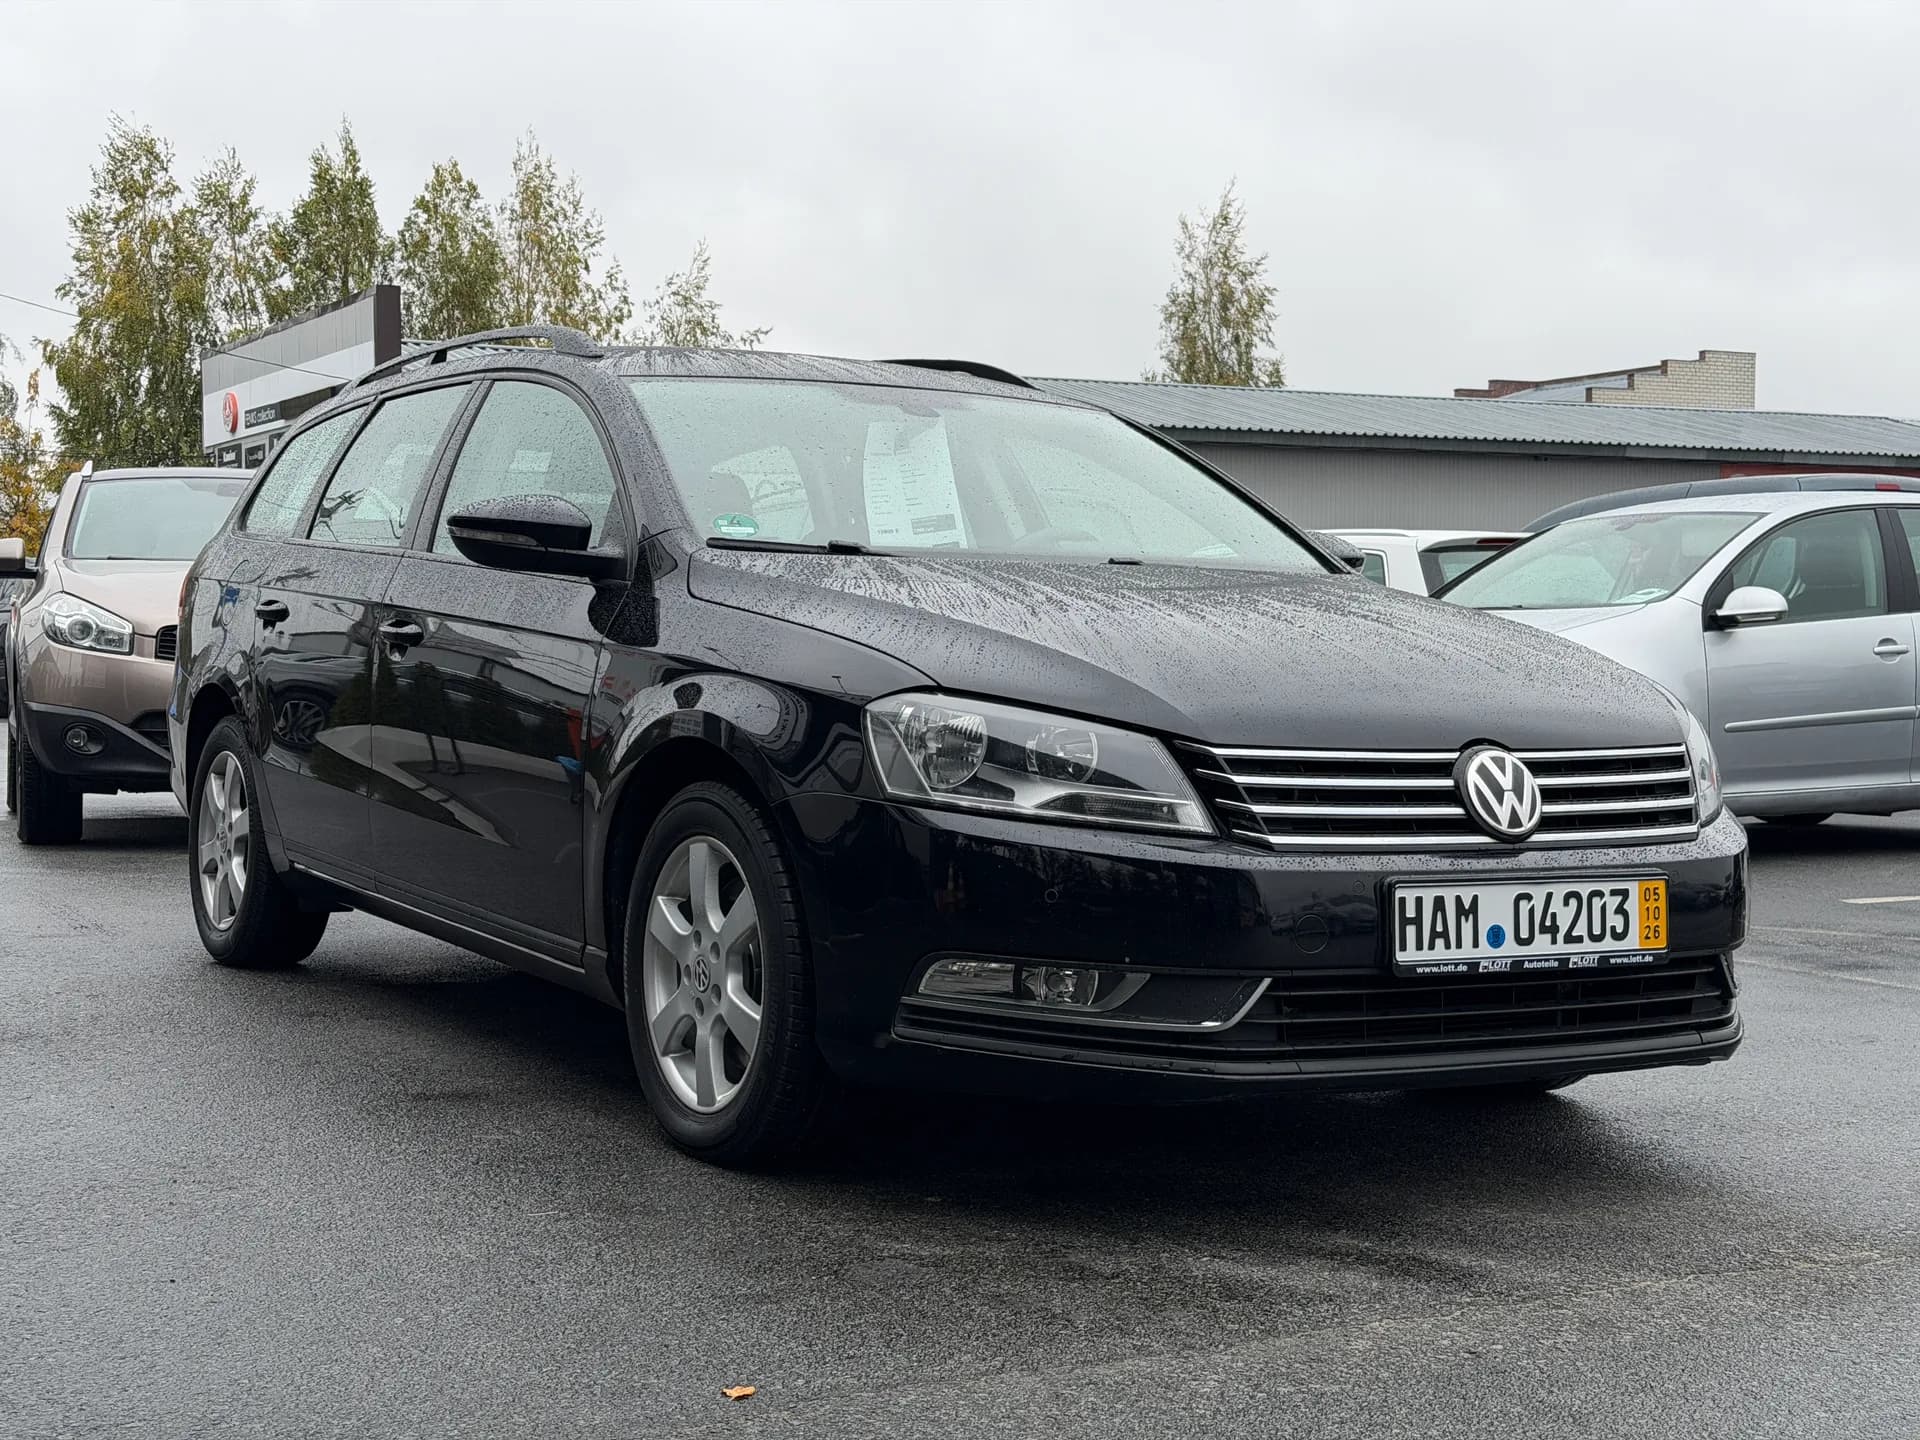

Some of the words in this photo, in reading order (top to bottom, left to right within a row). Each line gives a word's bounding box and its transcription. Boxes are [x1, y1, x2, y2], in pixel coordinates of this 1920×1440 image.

[1469, 752, 1540, 832] VW
[1644, 887, 1660, 902] 05
[1398, 893, 1480, 952] HAM
[1513, 888, 1631, 947] 04203
[1645, 906, 1660, 921] 10
[1644, 925, 1660, 940] 26
[1416, 963, 1468, 974] www.lott.de
[1523, 958, 1559, 969] Autoteile
[1609, 954, 1654, 965] www.lott.de
